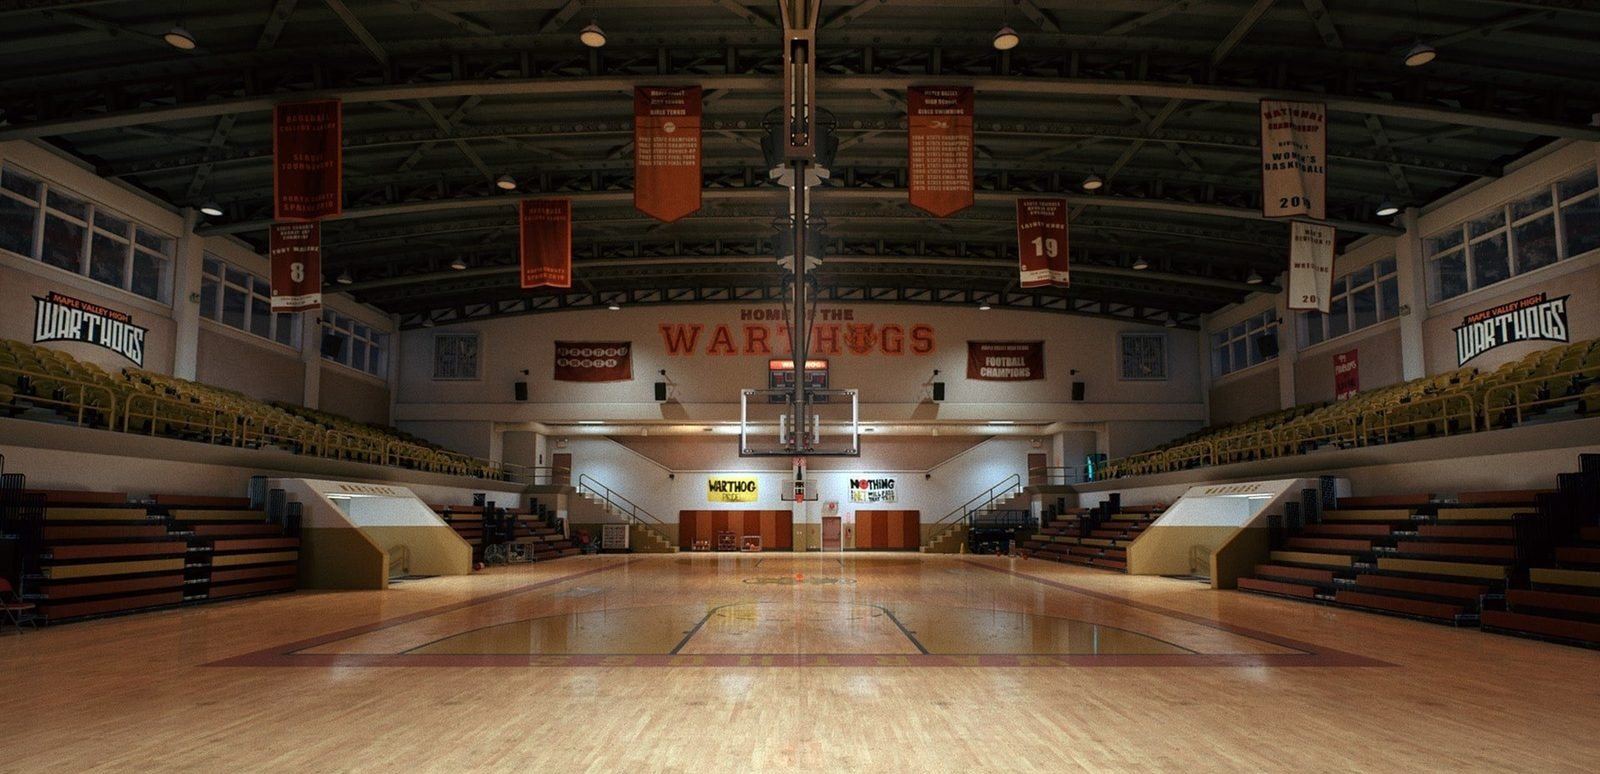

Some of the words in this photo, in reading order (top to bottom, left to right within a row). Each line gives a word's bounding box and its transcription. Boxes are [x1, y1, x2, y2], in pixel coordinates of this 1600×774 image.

[1032, 236, 1058, 258] 19
[290, 262, 304, 282] 8
[53, 294, 80, 308] MAPLE
[82, 302, 108, 316] VALLEY
[109, 310, 128, 322] HIGH
[741, 309, 790, 320] HOME
[820, 309, 854, 320] THE
[1468, 310, 1491, 324] MAPLE
[1492, 302, 1518, 316] VALLEY
[1520, 294, 1542, 308] HIGH
[35, 299, 146, 367] WARTHOGS
[1457, 298, 1567, 366] WARTHOGS
[986, 356, 1026, 366] FOOTBALL
[980, 367, 1031, 378] CHAMPIONS
[708, 480, 756, 492] WARTHOG
